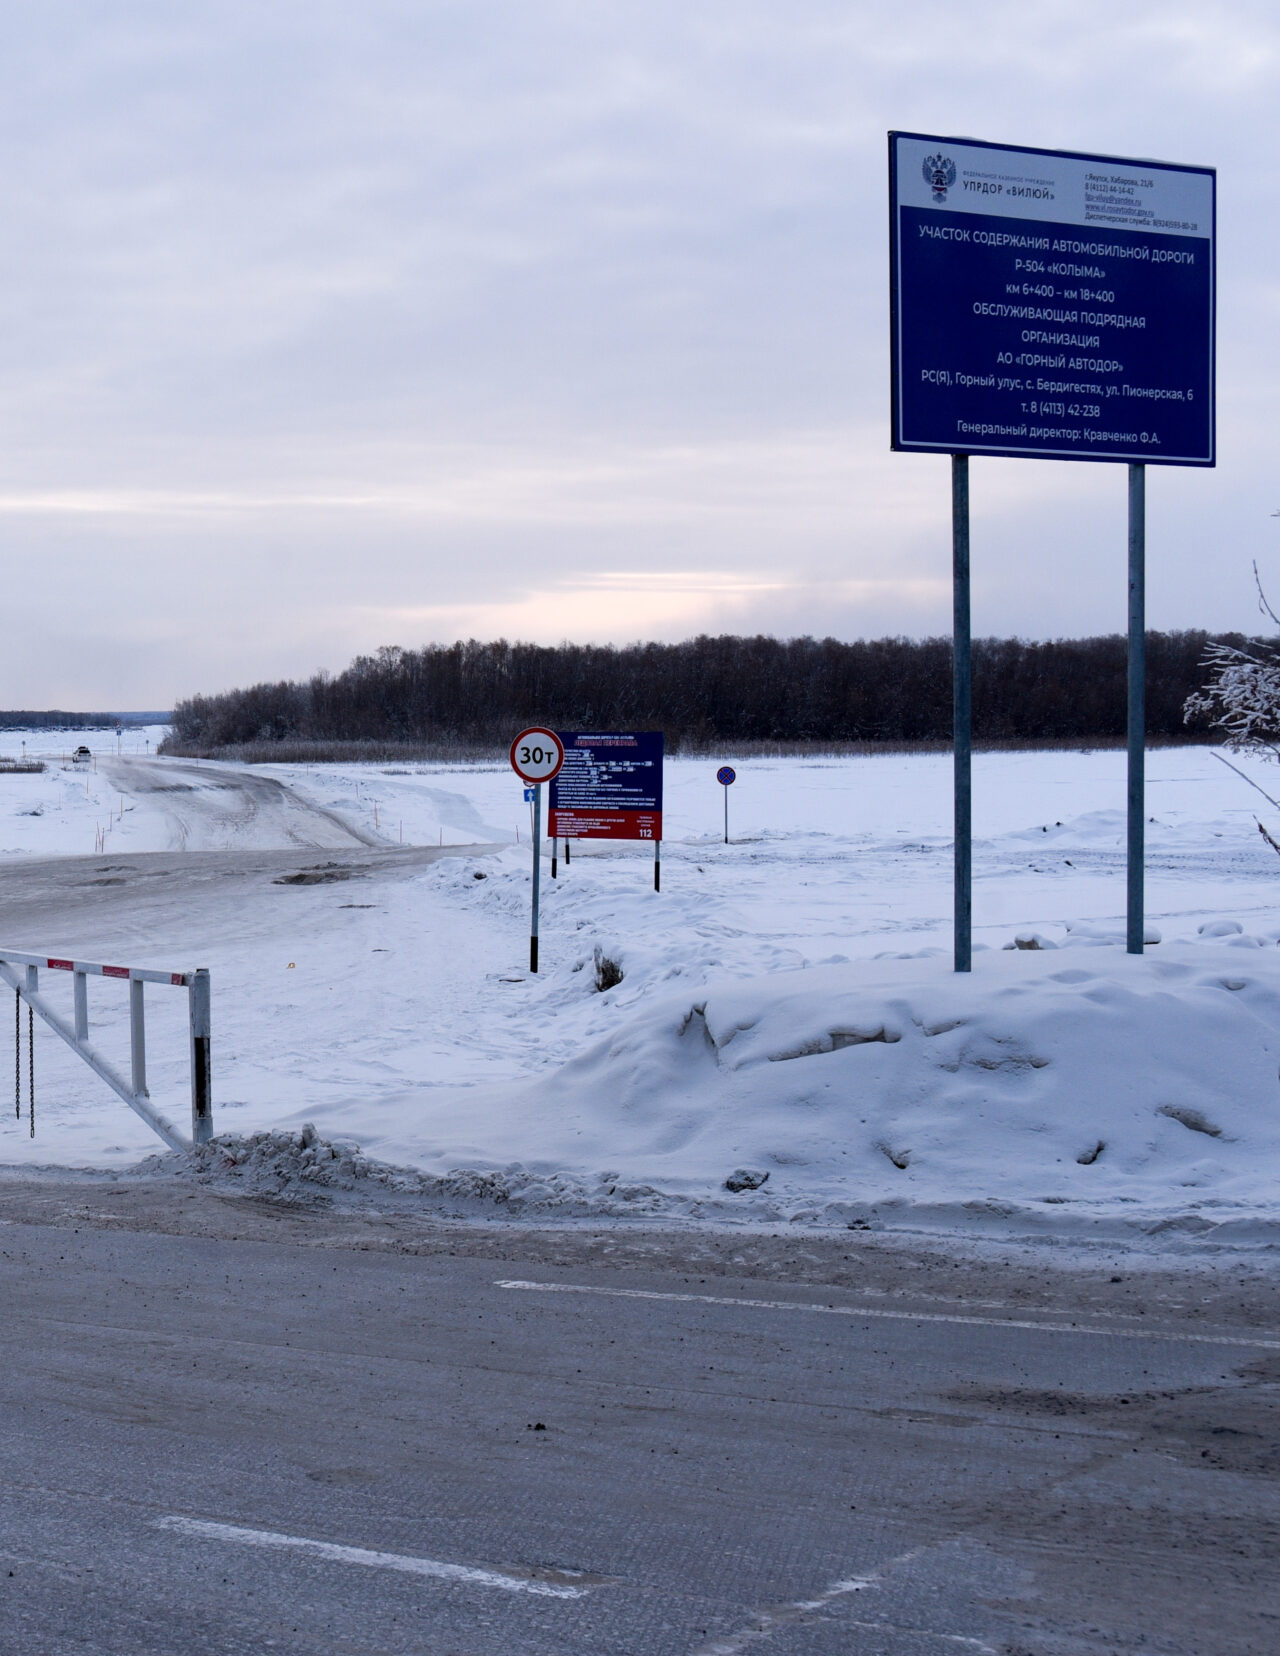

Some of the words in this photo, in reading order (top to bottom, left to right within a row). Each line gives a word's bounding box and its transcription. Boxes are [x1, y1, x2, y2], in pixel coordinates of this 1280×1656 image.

[963, 180, 1002, 194] УПРДОР
[1007, 186, 1054, 200] «ВИЛЮЙ»
[919, 225, 970, 241] УЧАСТОК
[973, 231, 1050, 250] СОДЕРЖАНИЯ
[1052, 239, 1149, 260] АВТОМОБИЛЬНОЙ
[1152, 250, 1194, 264] ДОРОГИ
[1016, 259, 1044, 272] Р-504
[1047, 263, 1105, 278] «КОЛЫМА»
[1006, 284, 1020, 294] км
[1022, 283, 1054, 297] 6+400
[1064, 290, 1077, 299] км
[1080, 289, 1114, 303] 18+400
[973, 302, 1077, 323] ОБСЛУЖИВАЮЩАЯ
[1081, 312, 1146, 328] ПОДРЯДНАЯ
[1022, 330, 1099, 348] ОРГАНИЗАЦИЯ
[997, 352, 1012, 364] АО
[1016, 354, 1065, 368] «ГОРНЫЙ
[1068, 358, 1123, 373] АВТОДОР»
[922, 370, 952, 386] РС(Я),
[956, 372, 995, 387] Горный
[998, 378, 1023, 390] улус,
[1026, 380, 1034, 389] с.
[1037, 378, 1103, 395] Бердигестях,
[1106, 385, 1119, 397] ул.
[1123, 385, 1185, 401] Пионерская,
[1187, 389, 1193, 400] 6
[1021, 403, 1028, 412] т.
[1031, 402, 1037, 413] 8
[1040, 402, 1064, 417] (4113)
[1068, 404, 1100, 417] 42-238
[957, 420, 1027, 436] Генеральный
[1029, 426, 1081, 441] директор:
[1084, 429, 1137, 442] Кравченко
[1140, 432, 1161, 443] Ф.А.
[639, 829, 652, 837] 112
